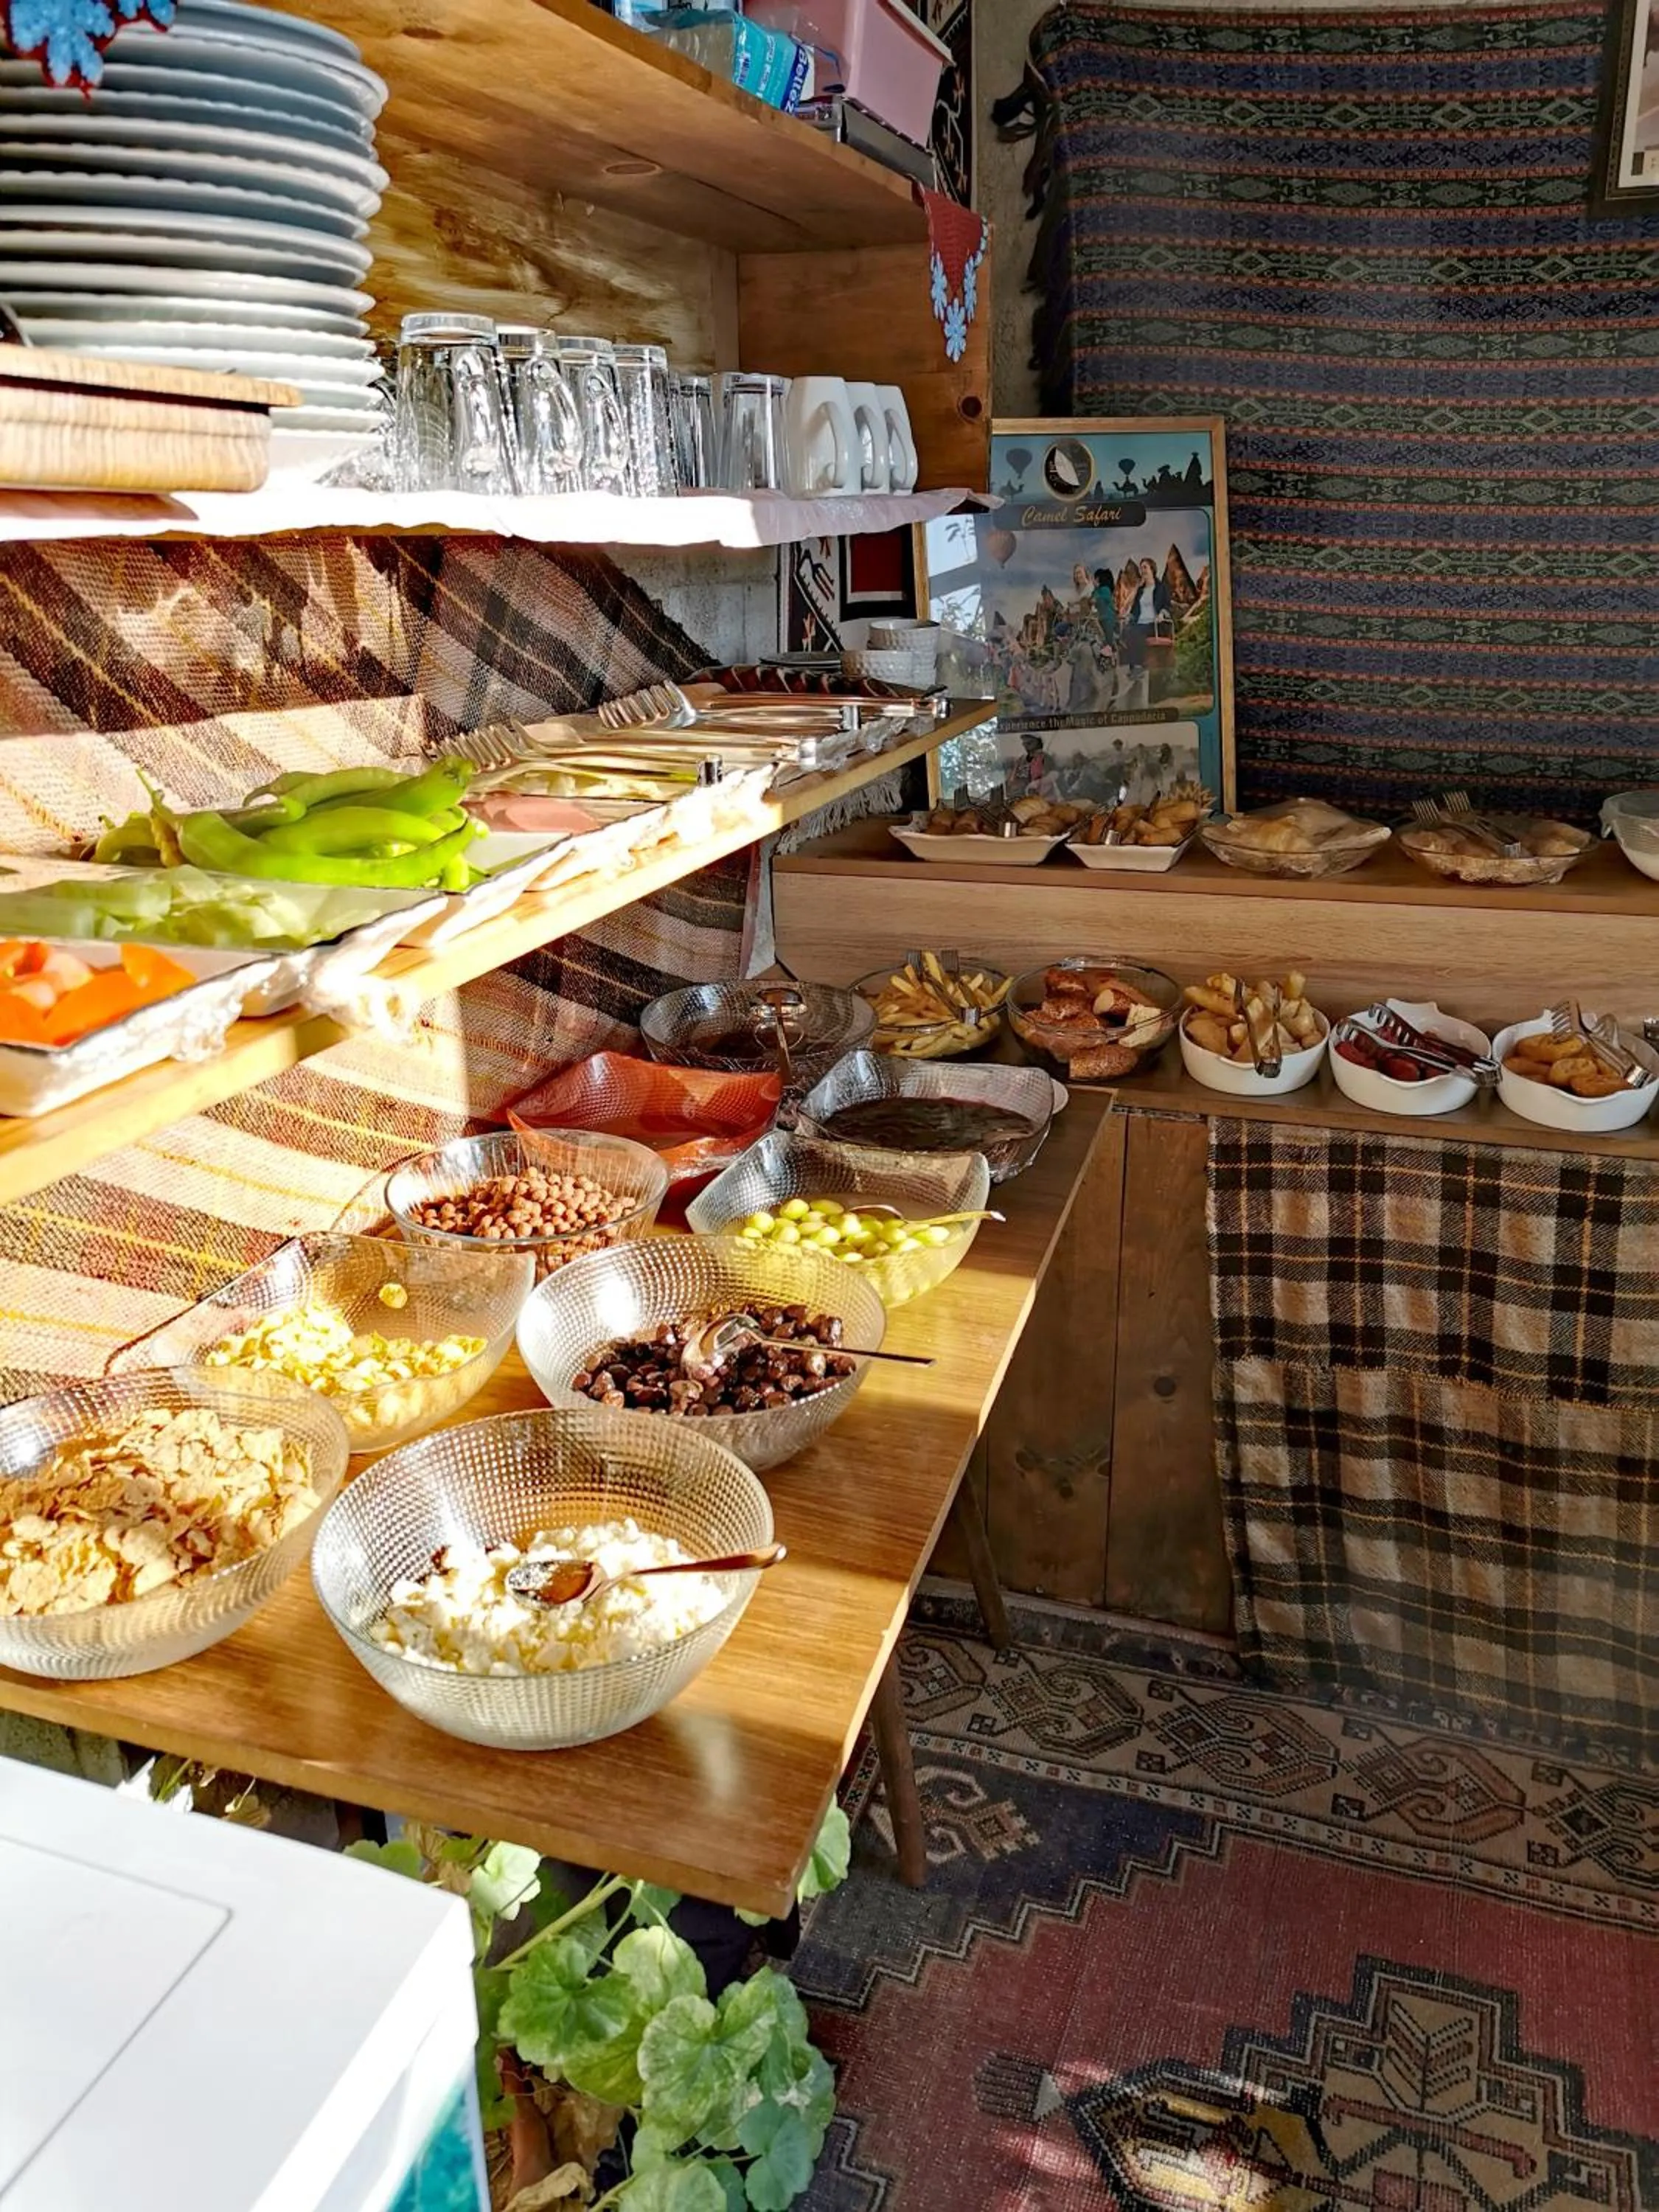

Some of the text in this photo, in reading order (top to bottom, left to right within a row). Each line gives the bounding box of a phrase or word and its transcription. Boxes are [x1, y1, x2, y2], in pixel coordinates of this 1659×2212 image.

[1021, 504, 1121, 527] Camel Safari
[998, 717, 1046, 731] xperience
[1065, 715, 1096, 728] Magic
[1098, 714, 1107, 725] of
